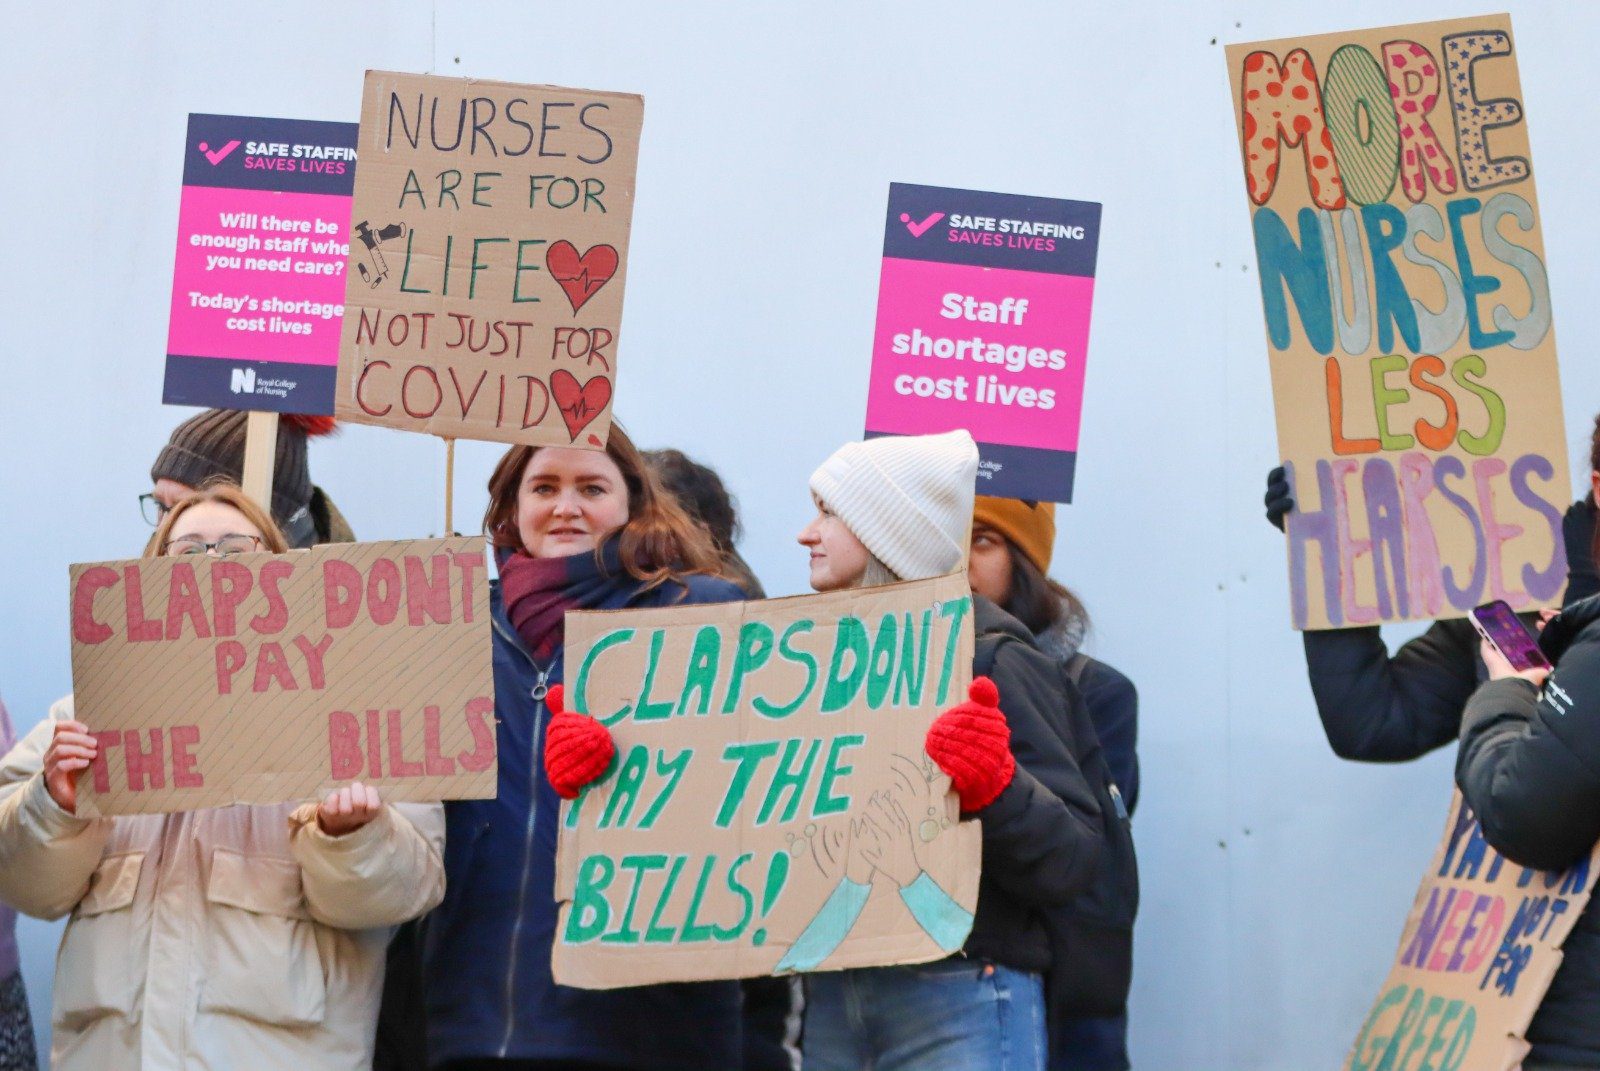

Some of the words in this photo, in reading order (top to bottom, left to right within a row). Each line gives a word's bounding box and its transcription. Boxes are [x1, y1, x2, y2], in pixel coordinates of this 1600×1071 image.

[386, 93, 613, 165] NURSES
[1241, 30, 1531, 211] MORE
[244, 157, 296, 171] SAVES
[301, 161, 346, 175] LIVES
[245, 142, 289, 157] SAFE
[292, 145, 358, 161] STAFFIN
[399, 169, 502, 211] ARE
[529, 175, 606, 213] FOR
[190, 234, 260, 252] enough
[264, 238, 309, 253] staff
[311, 240, 350, 256] whe
[219, 213, 257, 230] Will
[261, 216, 311, 232] there
[315, 218, 339, 234] be
[948, 229, 1004, 247] SAVES
[1008, 236, 1056, 251] LIVES
[949, 214, 996, 232] SAFE
[998, 219, 1085, 240] STAFFING
[206, 254, 241, 271] you
[245, 257, 290, 272] need
[294, 261, 344, 276] care?
[400, 229, 547, 302] LIFE
[1253, 192, 1551, 356] NURSES
[188, 291, 259, 314] Today's
[262, 297, 344, 319] shortage
[226, 317, 266, 331] cost
[269, 316, 312, 335] lives
[940, 292, 1029, 326] Staff
[356, 308, 435, 349] NOT
[446, 312, 533, 359] JUST
[552, 327, 612, 372] FOR
[892, 329, 1067, 372] shortages
[257, 378, 274, 388] Royal
[275, 380, 297, 390] College
[265, 388, 287, 398] Nursing
[356, 361, 549, 430] COVID
[894, 374, 969, 401] cost
[975, 375, 1056, 410] lives
[1325, 354, 1506, 456] LESS
[979, 461, 1003, 472] College
[1283, 452, 1570, 630] HEARSES
[73, 559, 296, 644] CLAPS
[214, 633, 334, 695] PAY
[573, 619, 818, 727] CLAPS
[88, 725, 204, 794] THE
[329, 697, 496, 781] BILLS
[713, 734, 866, 830] THE
[562, 850, 790, 948] BILLS!
[1504, 895, 1568, 943] NOT
[1400, 887, 1506, 974] NEED
[1350, 984, 1477, 1071] GREED
